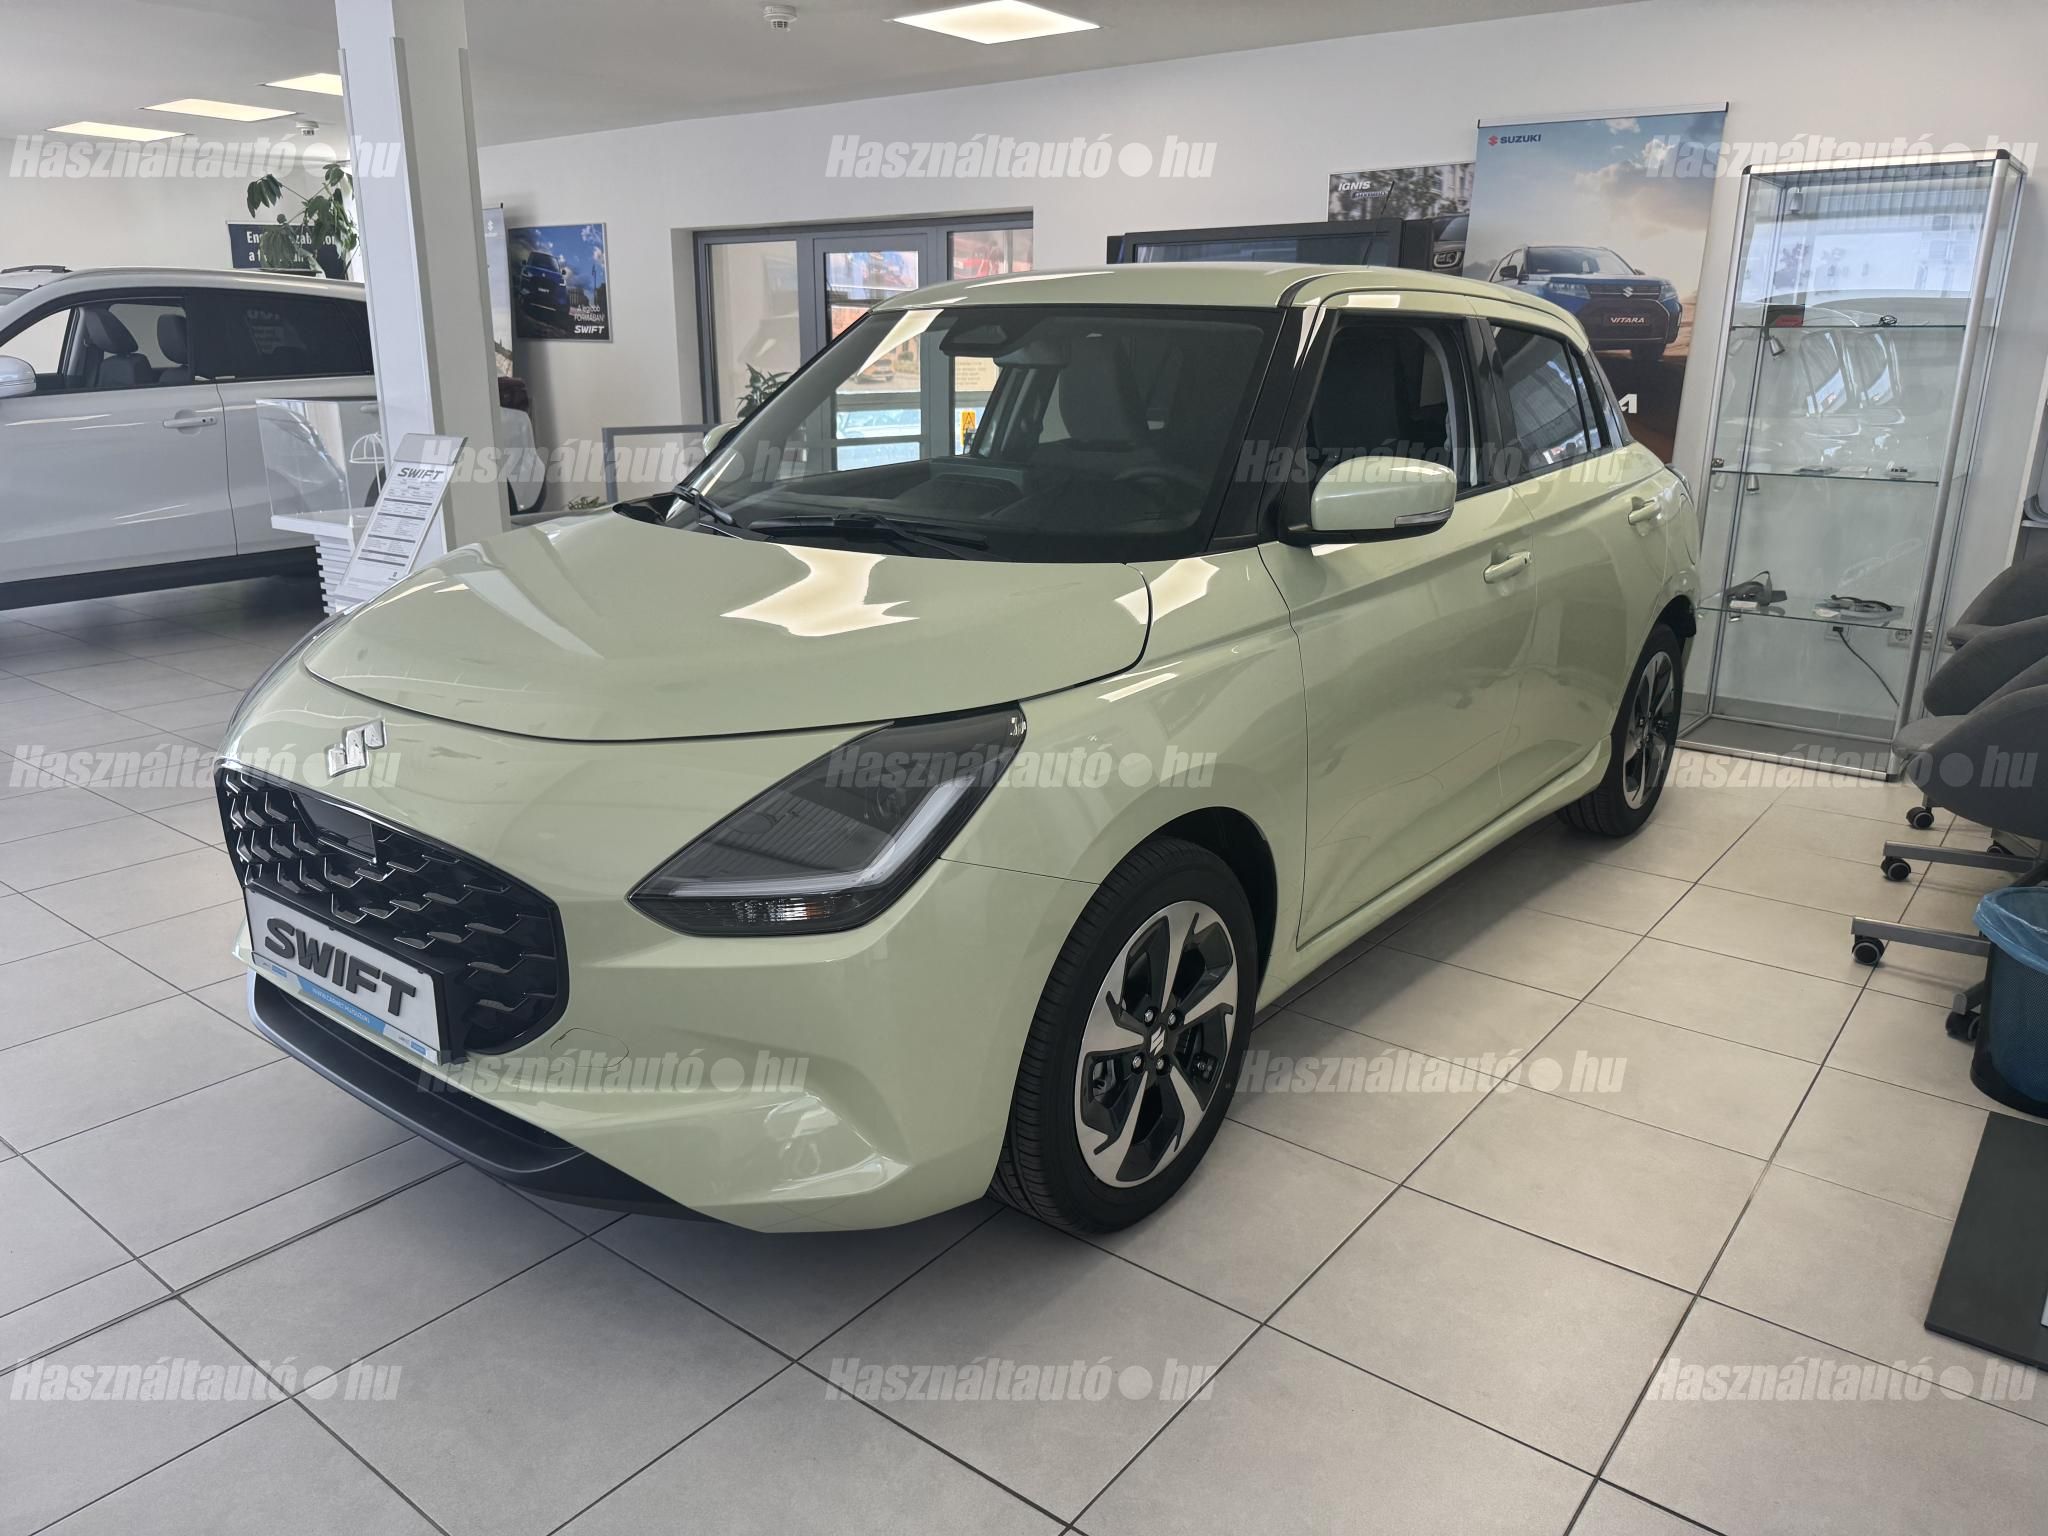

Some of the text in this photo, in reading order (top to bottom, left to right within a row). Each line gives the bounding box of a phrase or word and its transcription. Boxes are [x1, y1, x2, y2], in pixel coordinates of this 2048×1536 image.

[1500, 134, 1542, 144] SUZUKI
[1338, 181, 1371, 191] IGNIS
[574, 325, 605, 334] SWIFT
[397, 467, 444, 480] SWIFT
[265, 918, 416, 1017] SWIFT
